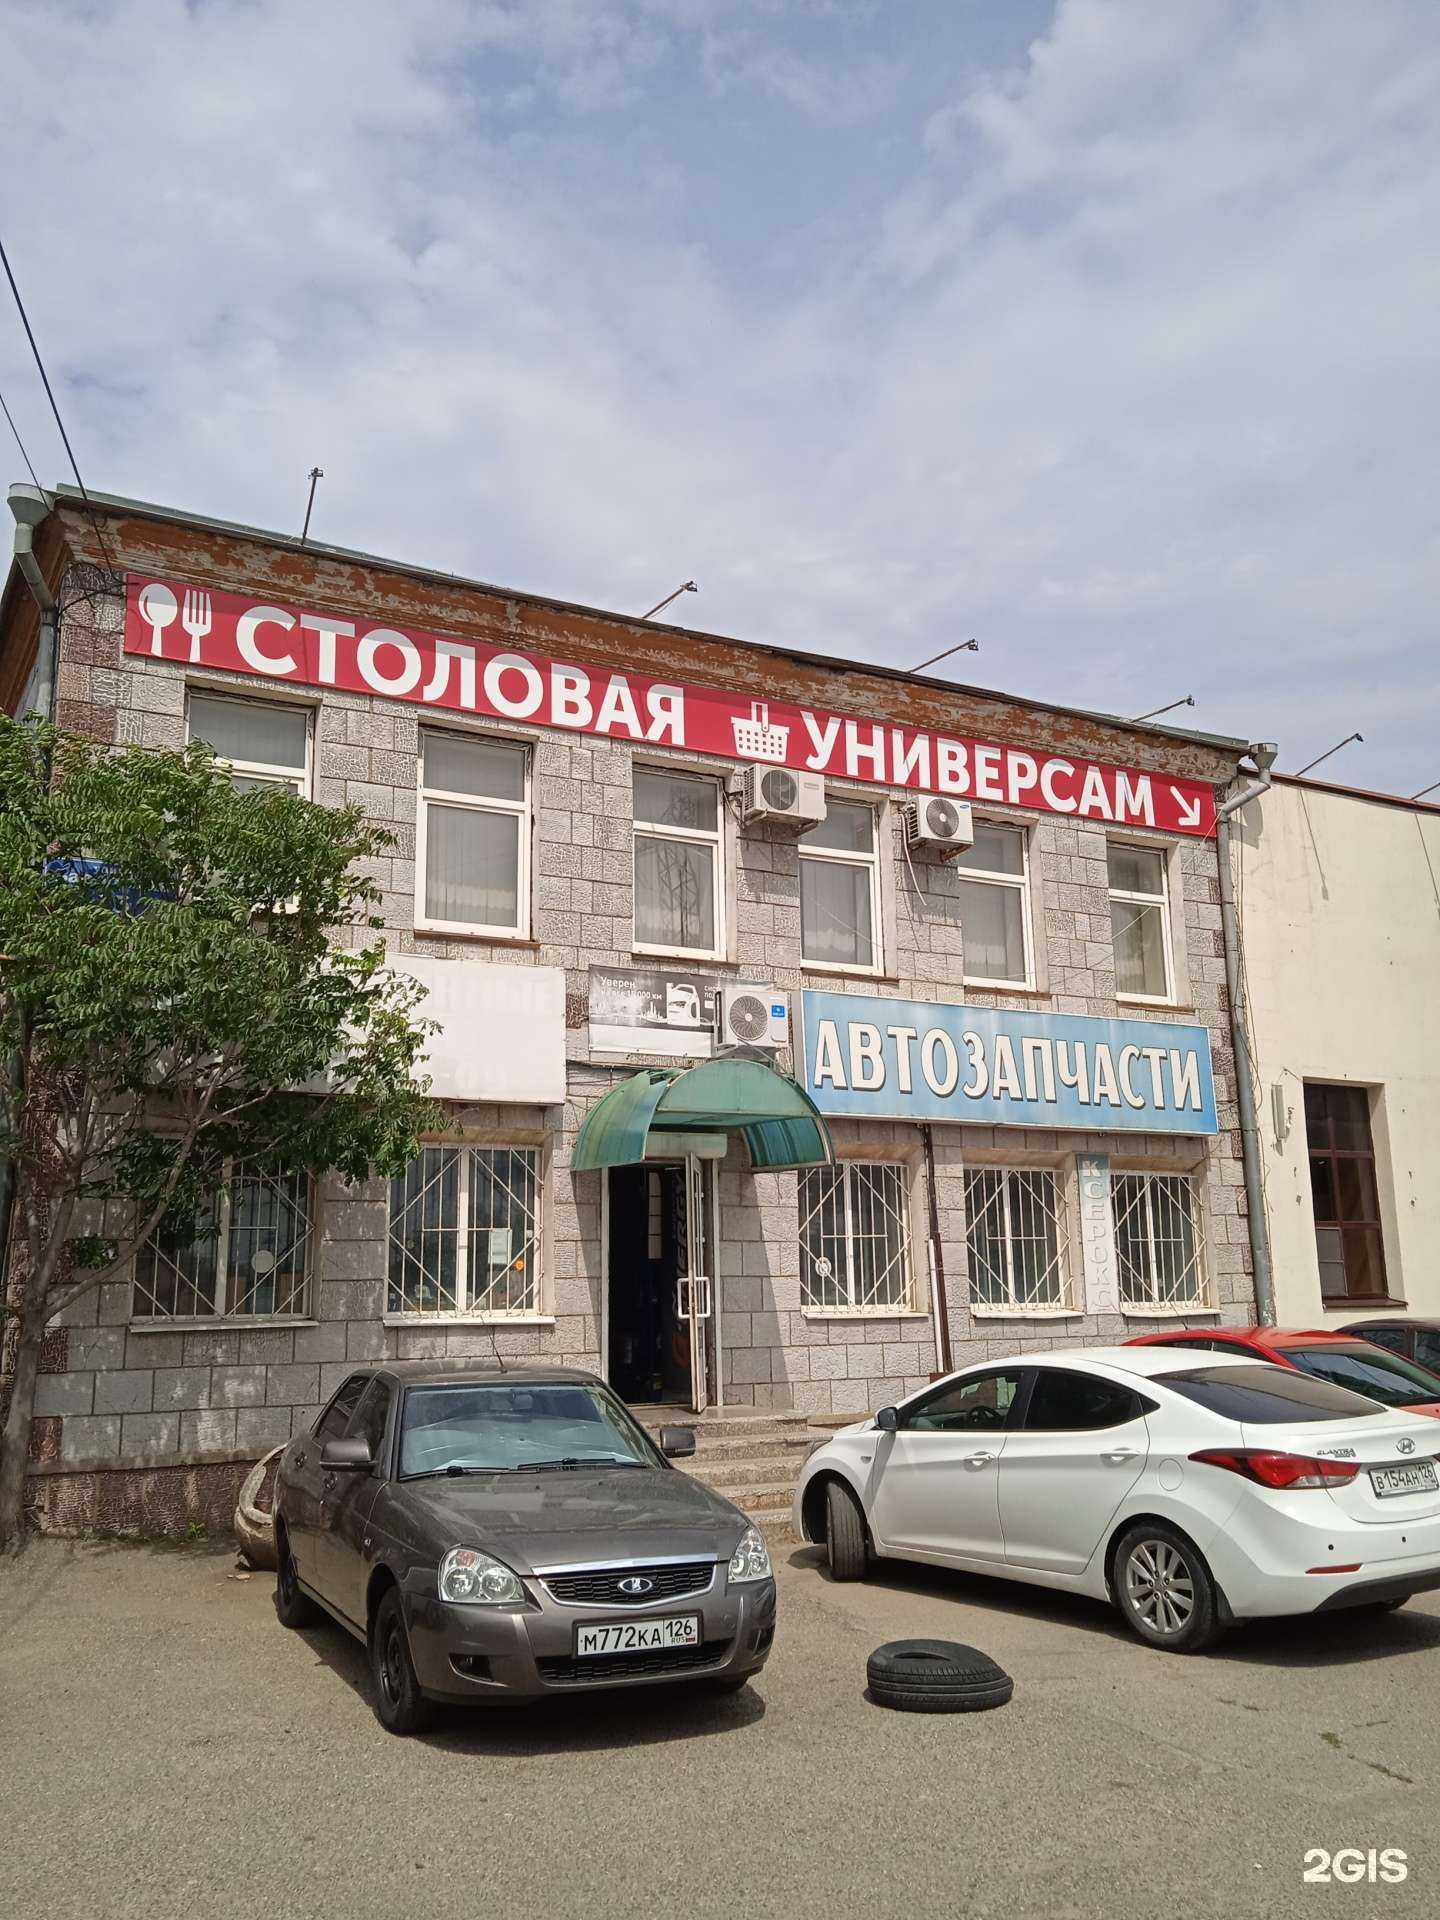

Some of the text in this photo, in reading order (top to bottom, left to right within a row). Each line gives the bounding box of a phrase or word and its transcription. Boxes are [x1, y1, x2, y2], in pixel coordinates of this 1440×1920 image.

[236, 606, 685, 746] СТОЛОВАЯ
[800, 711, 1157, 825] УНИВЕРСАМ
[600, 976, 636, 989] Уверен
[814, 1019, 1203, 1112] АВТОЗАПЧАСТИ
[584, 1619, 692, 1652] М772КА 126
[671, 1636, 685, 1645] RUS
